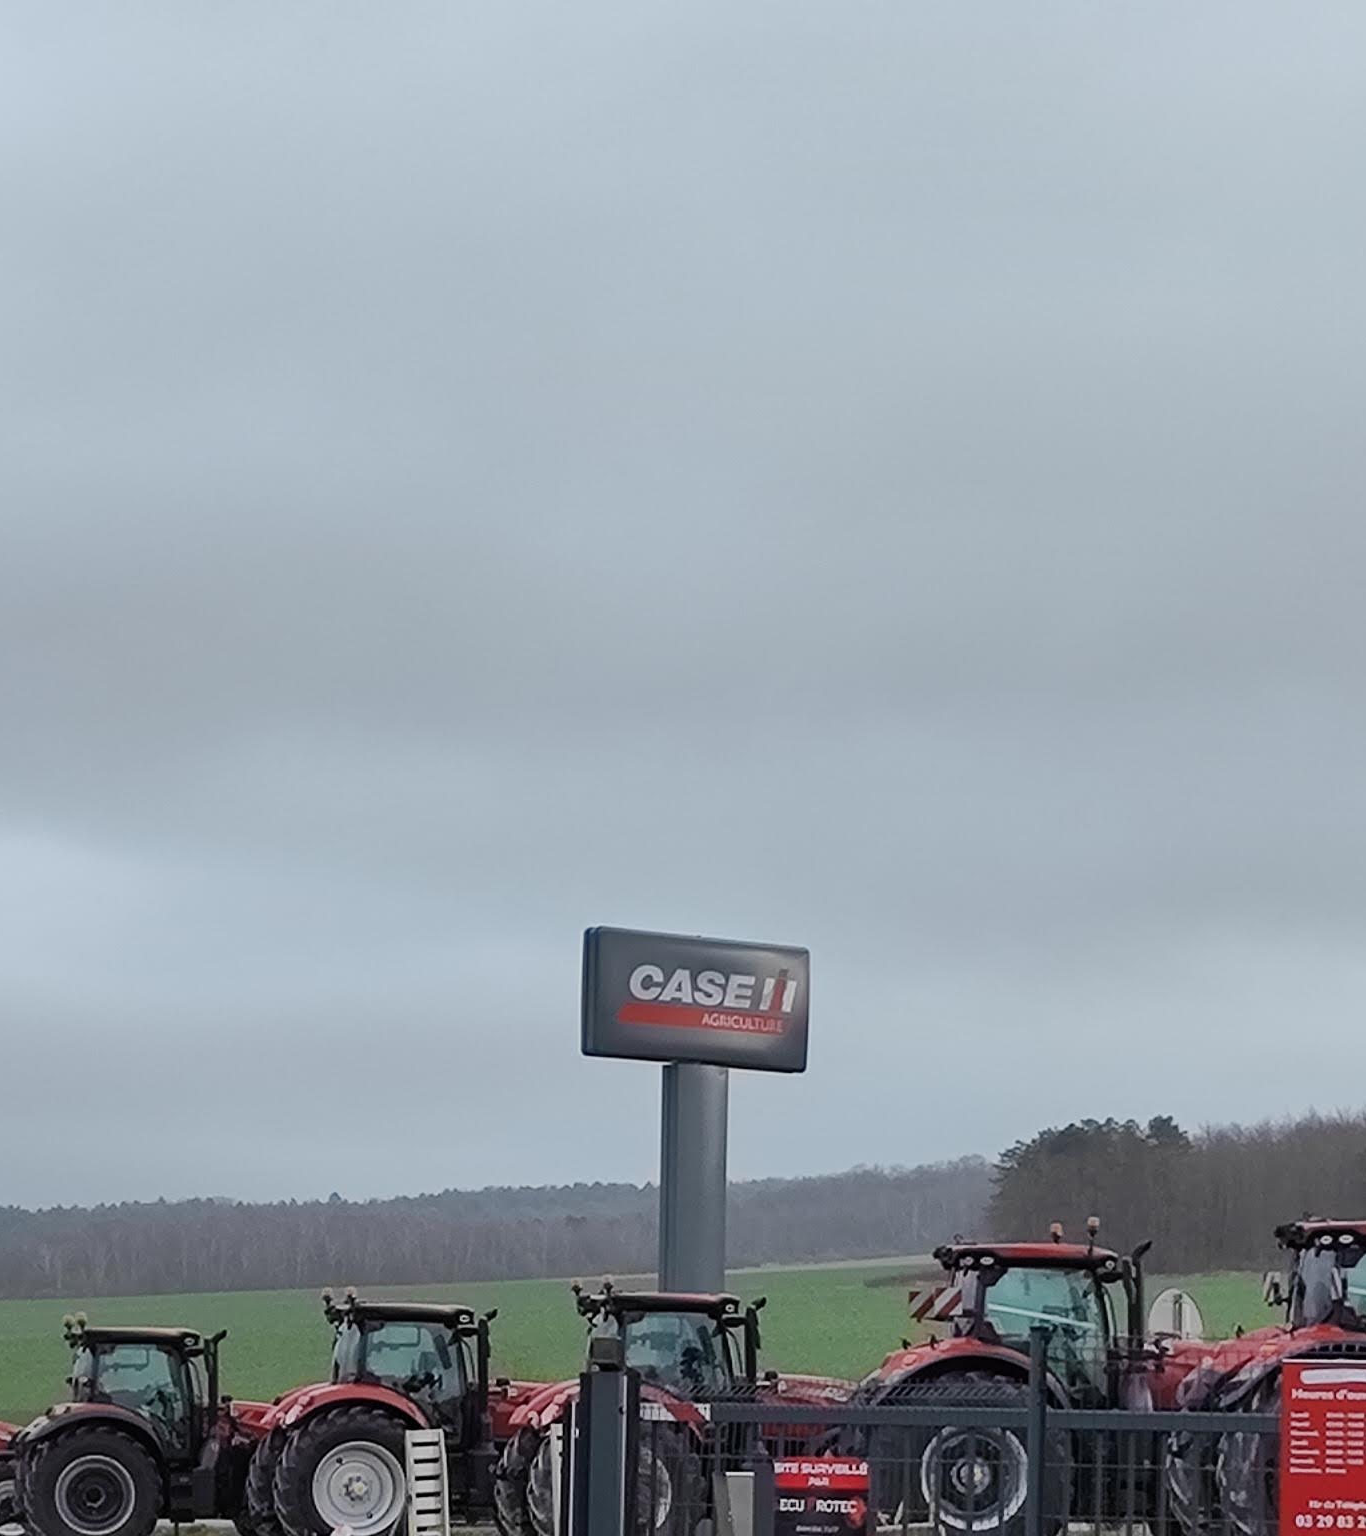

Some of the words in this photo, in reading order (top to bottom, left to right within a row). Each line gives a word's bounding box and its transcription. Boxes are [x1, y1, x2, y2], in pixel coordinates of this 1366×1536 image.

[629, 964, 756, 1008] CASE
[701, 1012, 783, 1033] AGRICULTURE
[1295, 1514, 1314, 1528] 03
[1316, 1514, 1334, 1529] 29
[1336, 1514, 1354, 1529] 83
